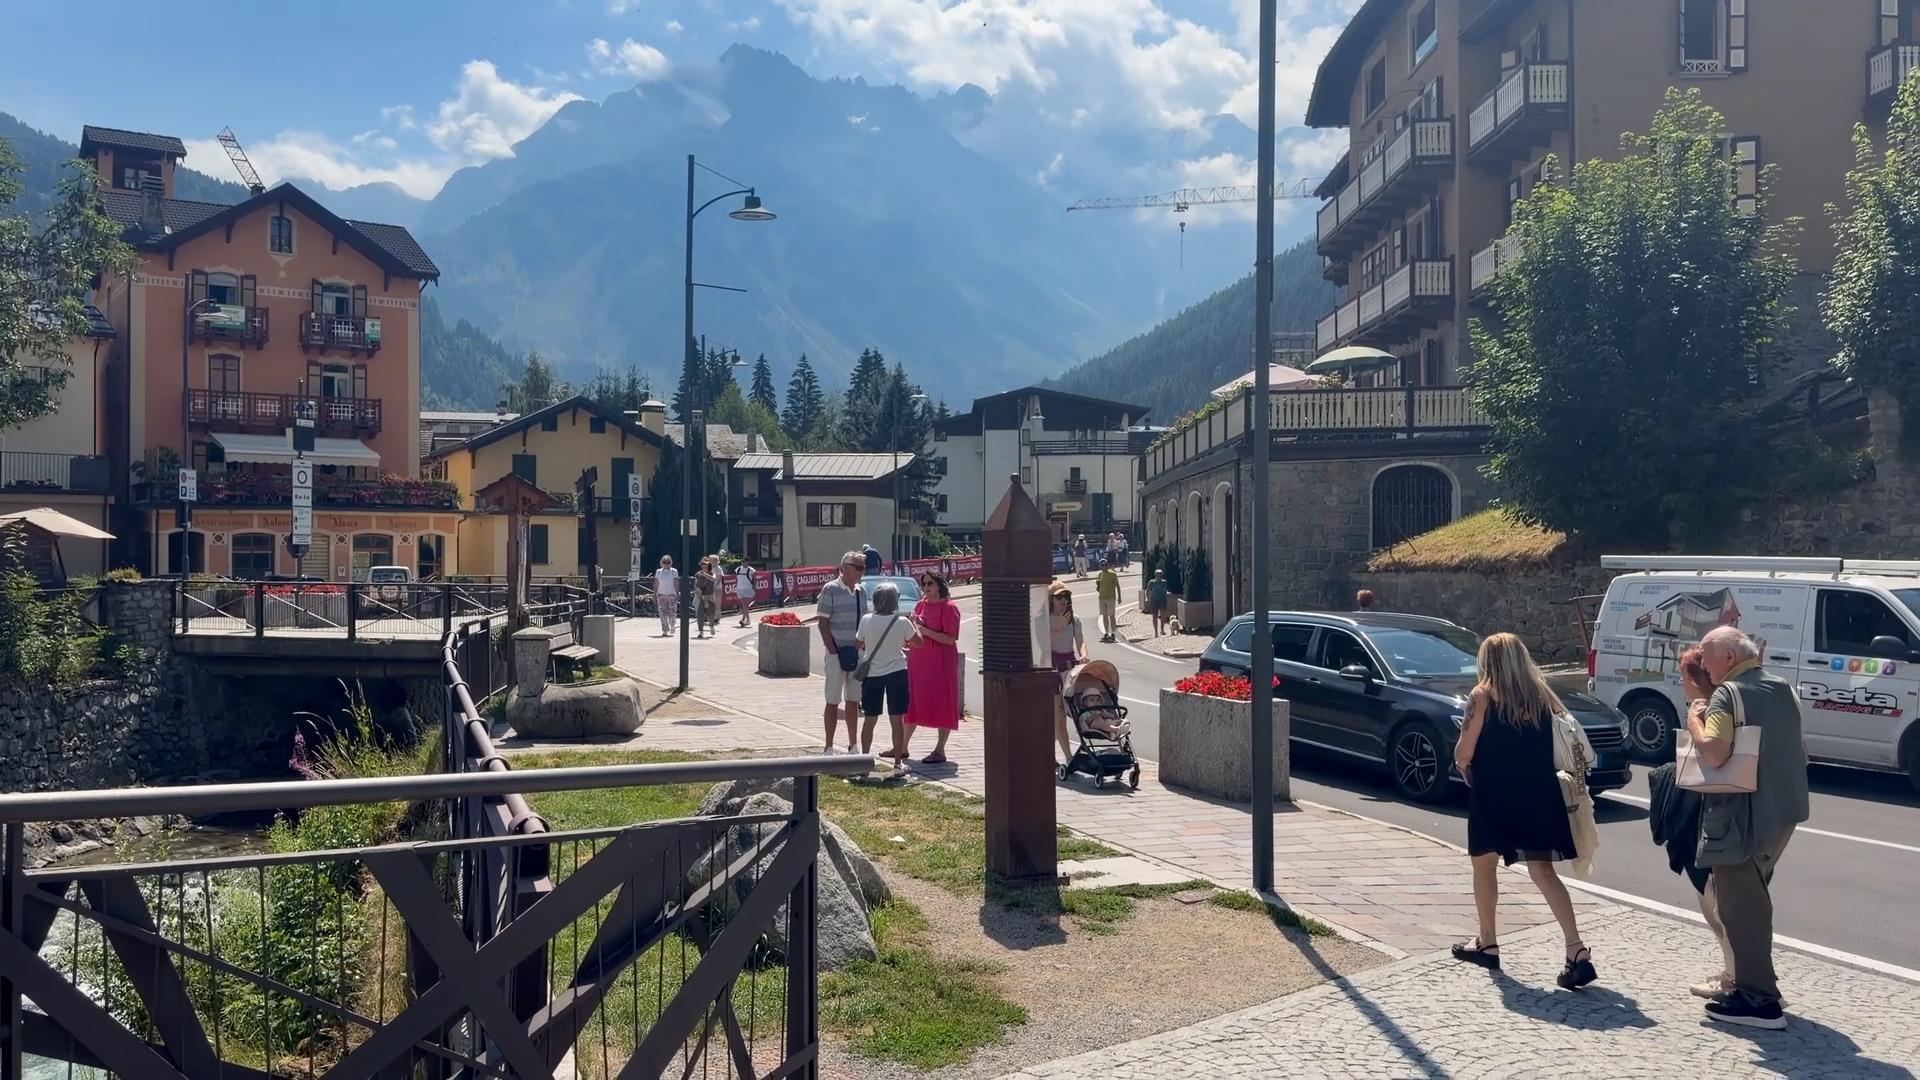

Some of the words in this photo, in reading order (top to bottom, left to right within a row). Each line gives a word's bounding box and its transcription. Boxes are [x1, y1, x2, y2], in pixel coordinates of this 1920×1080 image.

[755, 580, 769, 590] LCIO
[797, 575, 819, 585] CAGLIARI
[819, 573, 836, 583] CALCIO
[1800, 681, 1898, 710] Beta
[1812, 700, 1873, 714] RACING
